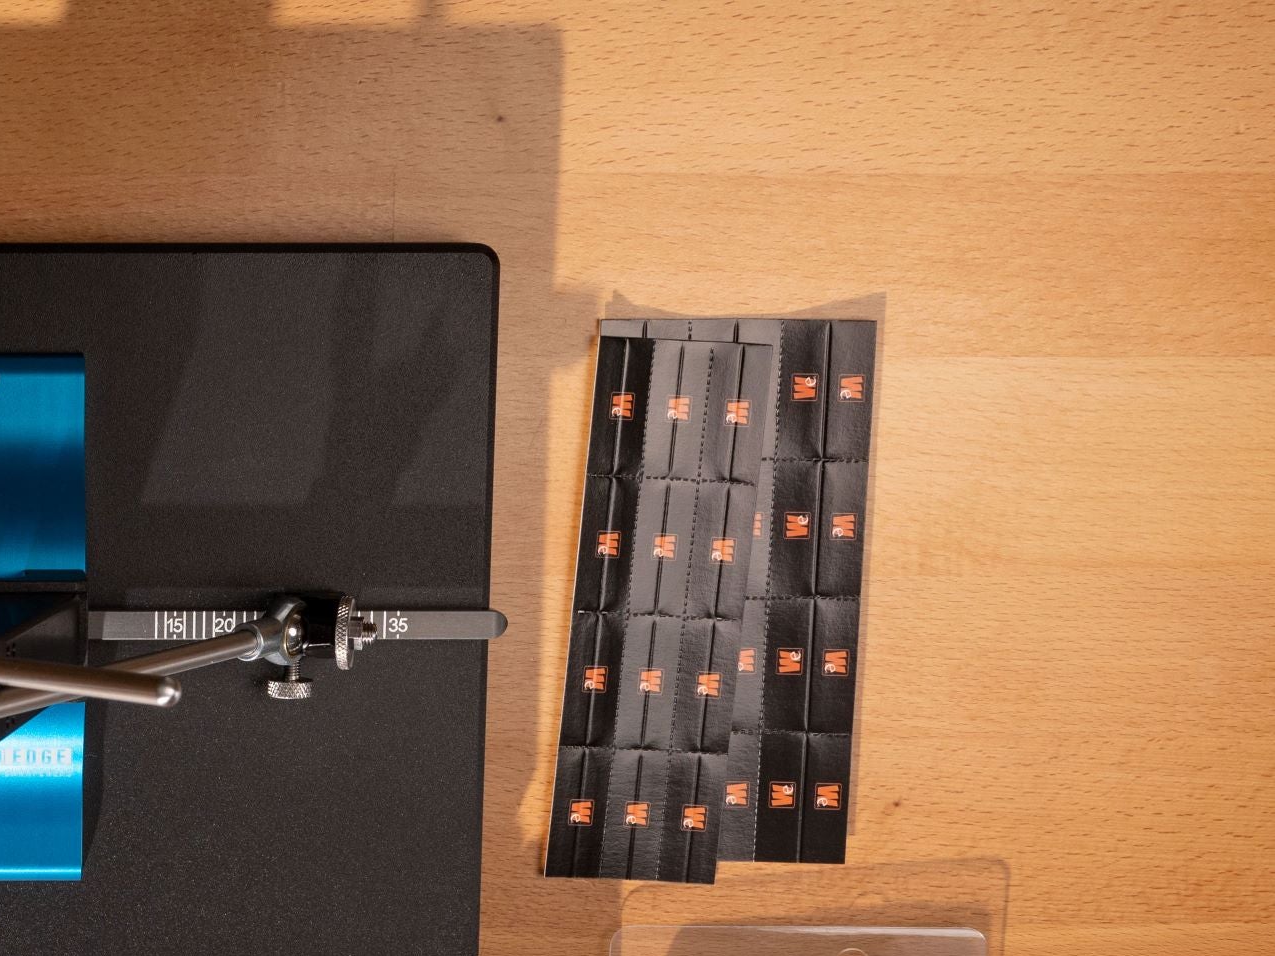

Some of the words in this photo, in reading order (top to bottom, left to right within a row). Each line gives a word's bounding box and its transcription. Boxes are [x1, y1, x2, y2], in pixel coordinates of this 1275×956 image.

[167, 618, 183, 633] 15
[215, 618, 234, 632] 20
[388, 617, 409, 633] 35
